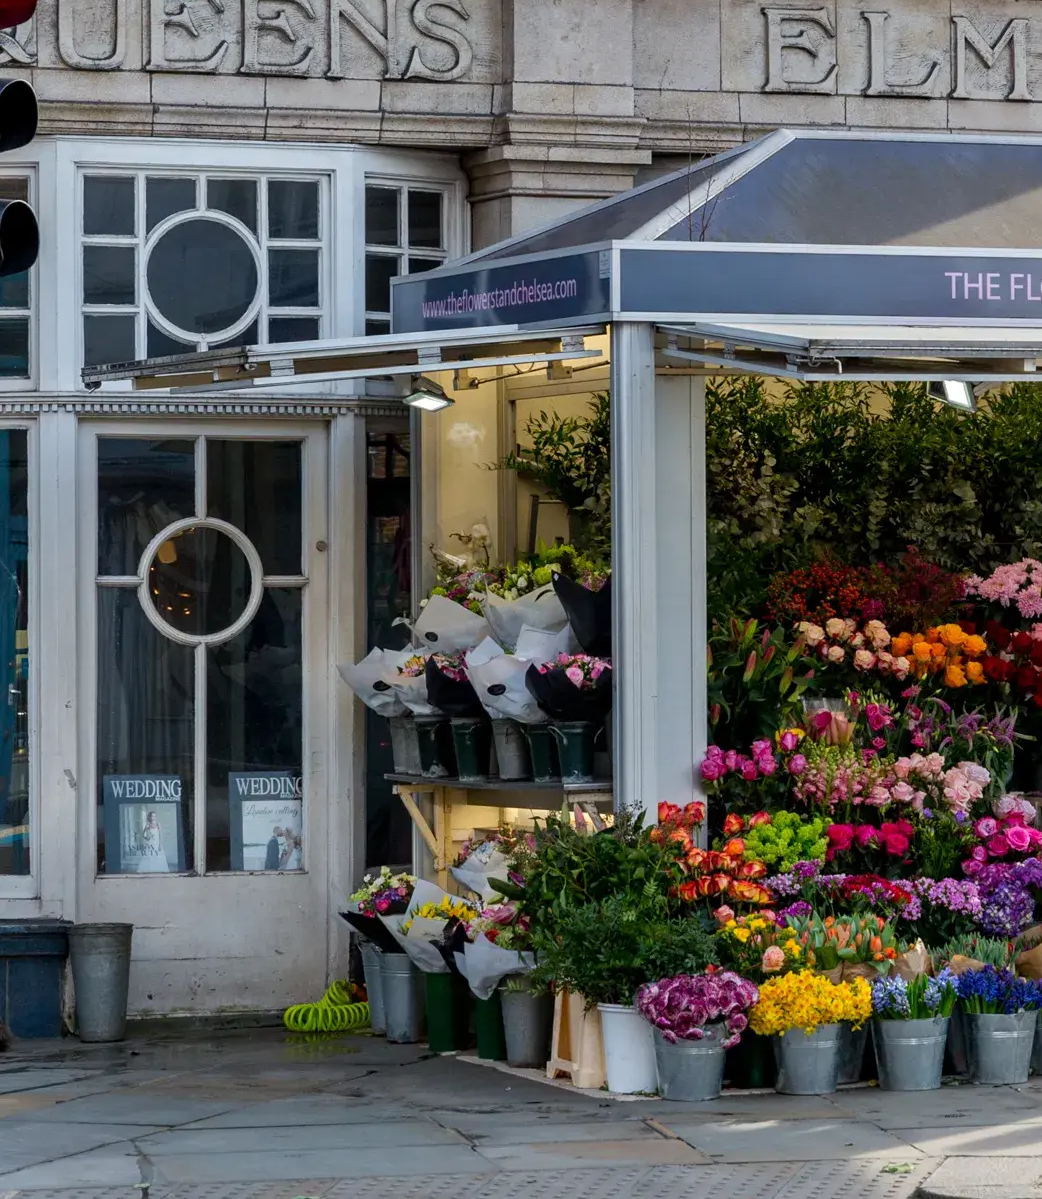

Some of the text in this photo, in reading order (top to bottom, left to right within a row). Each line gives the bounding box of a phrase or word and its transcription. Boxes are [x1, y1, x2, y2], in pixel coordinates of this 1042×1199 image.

[761, 6, 1033, 102] ELM
[421, 278, 577, 319] www.theflowerstandchelsea.com
[944, 272, 1001, 301] THE
[110, 779, 182, 798] WEDDING
